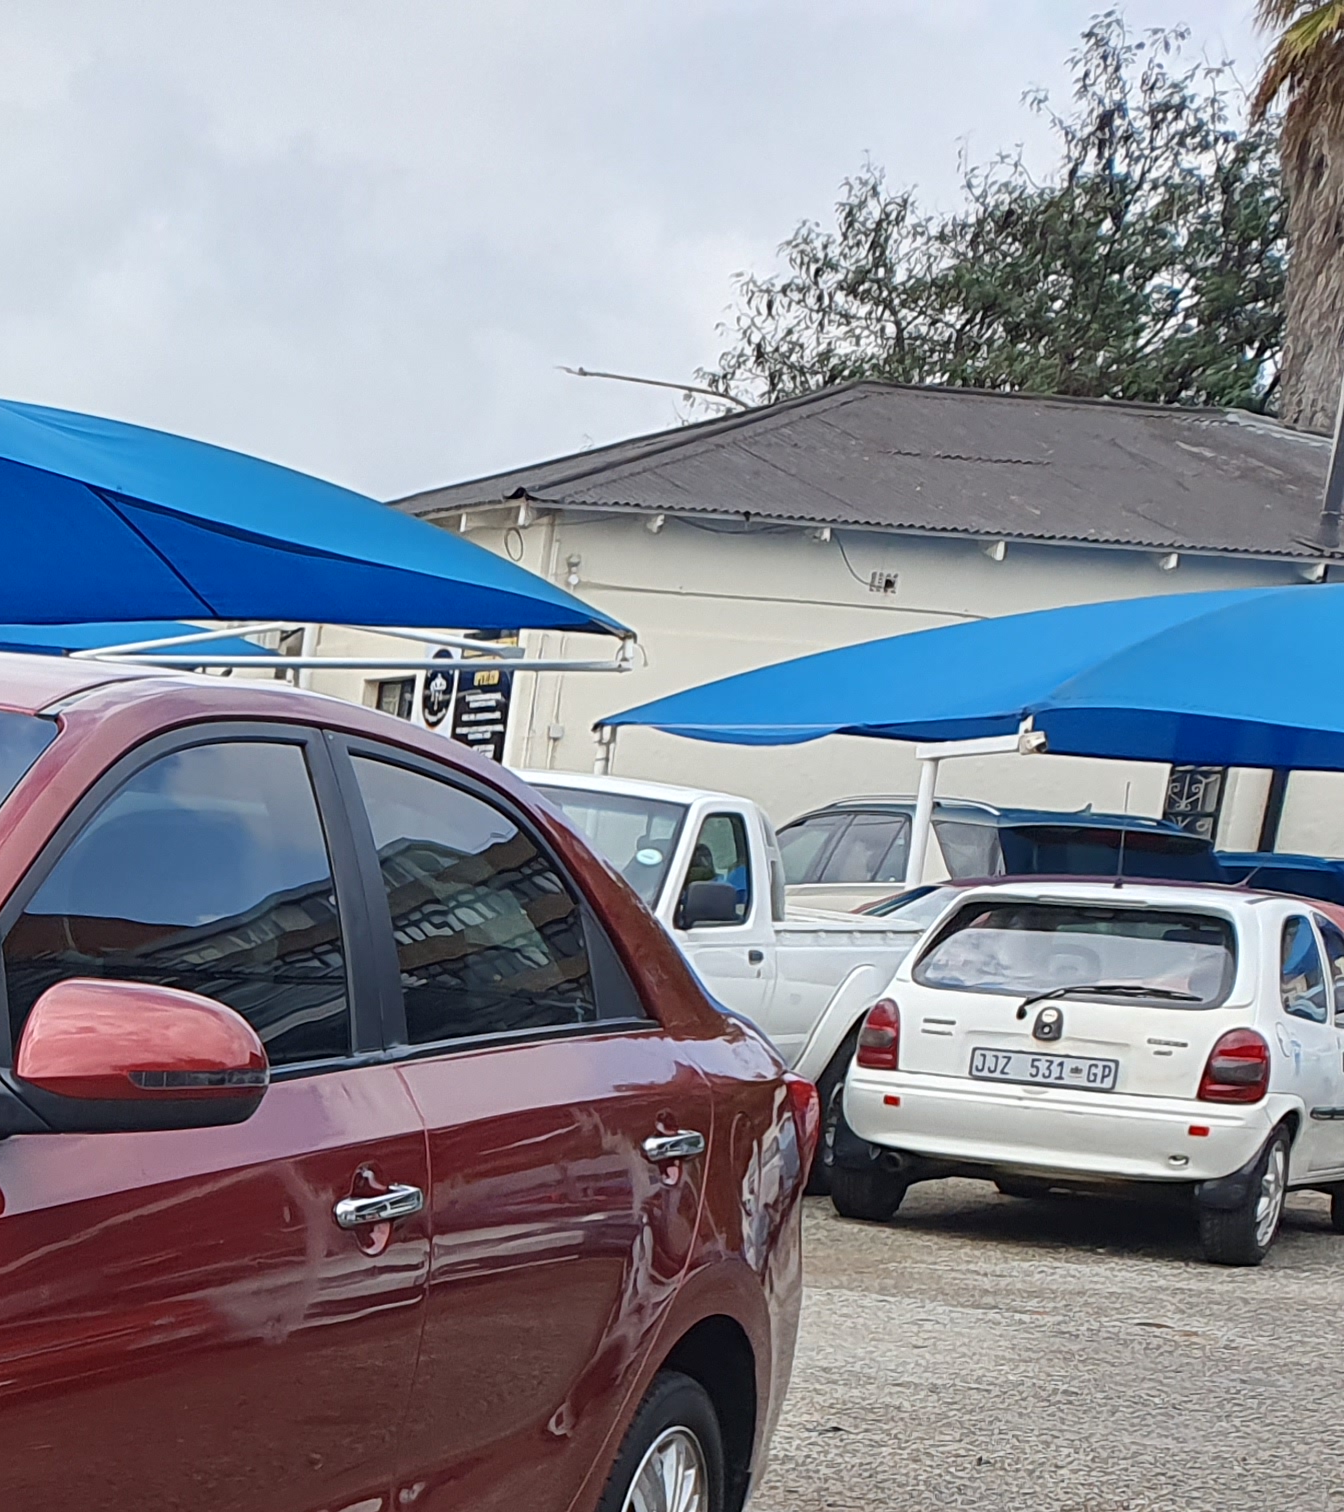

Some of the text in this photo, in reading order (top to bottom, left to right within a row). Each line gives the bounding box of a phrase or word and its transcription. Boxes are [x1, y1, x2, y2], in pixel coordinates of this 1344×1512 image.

[974, 1053, 1112, 1084] JJZ 531 GP
